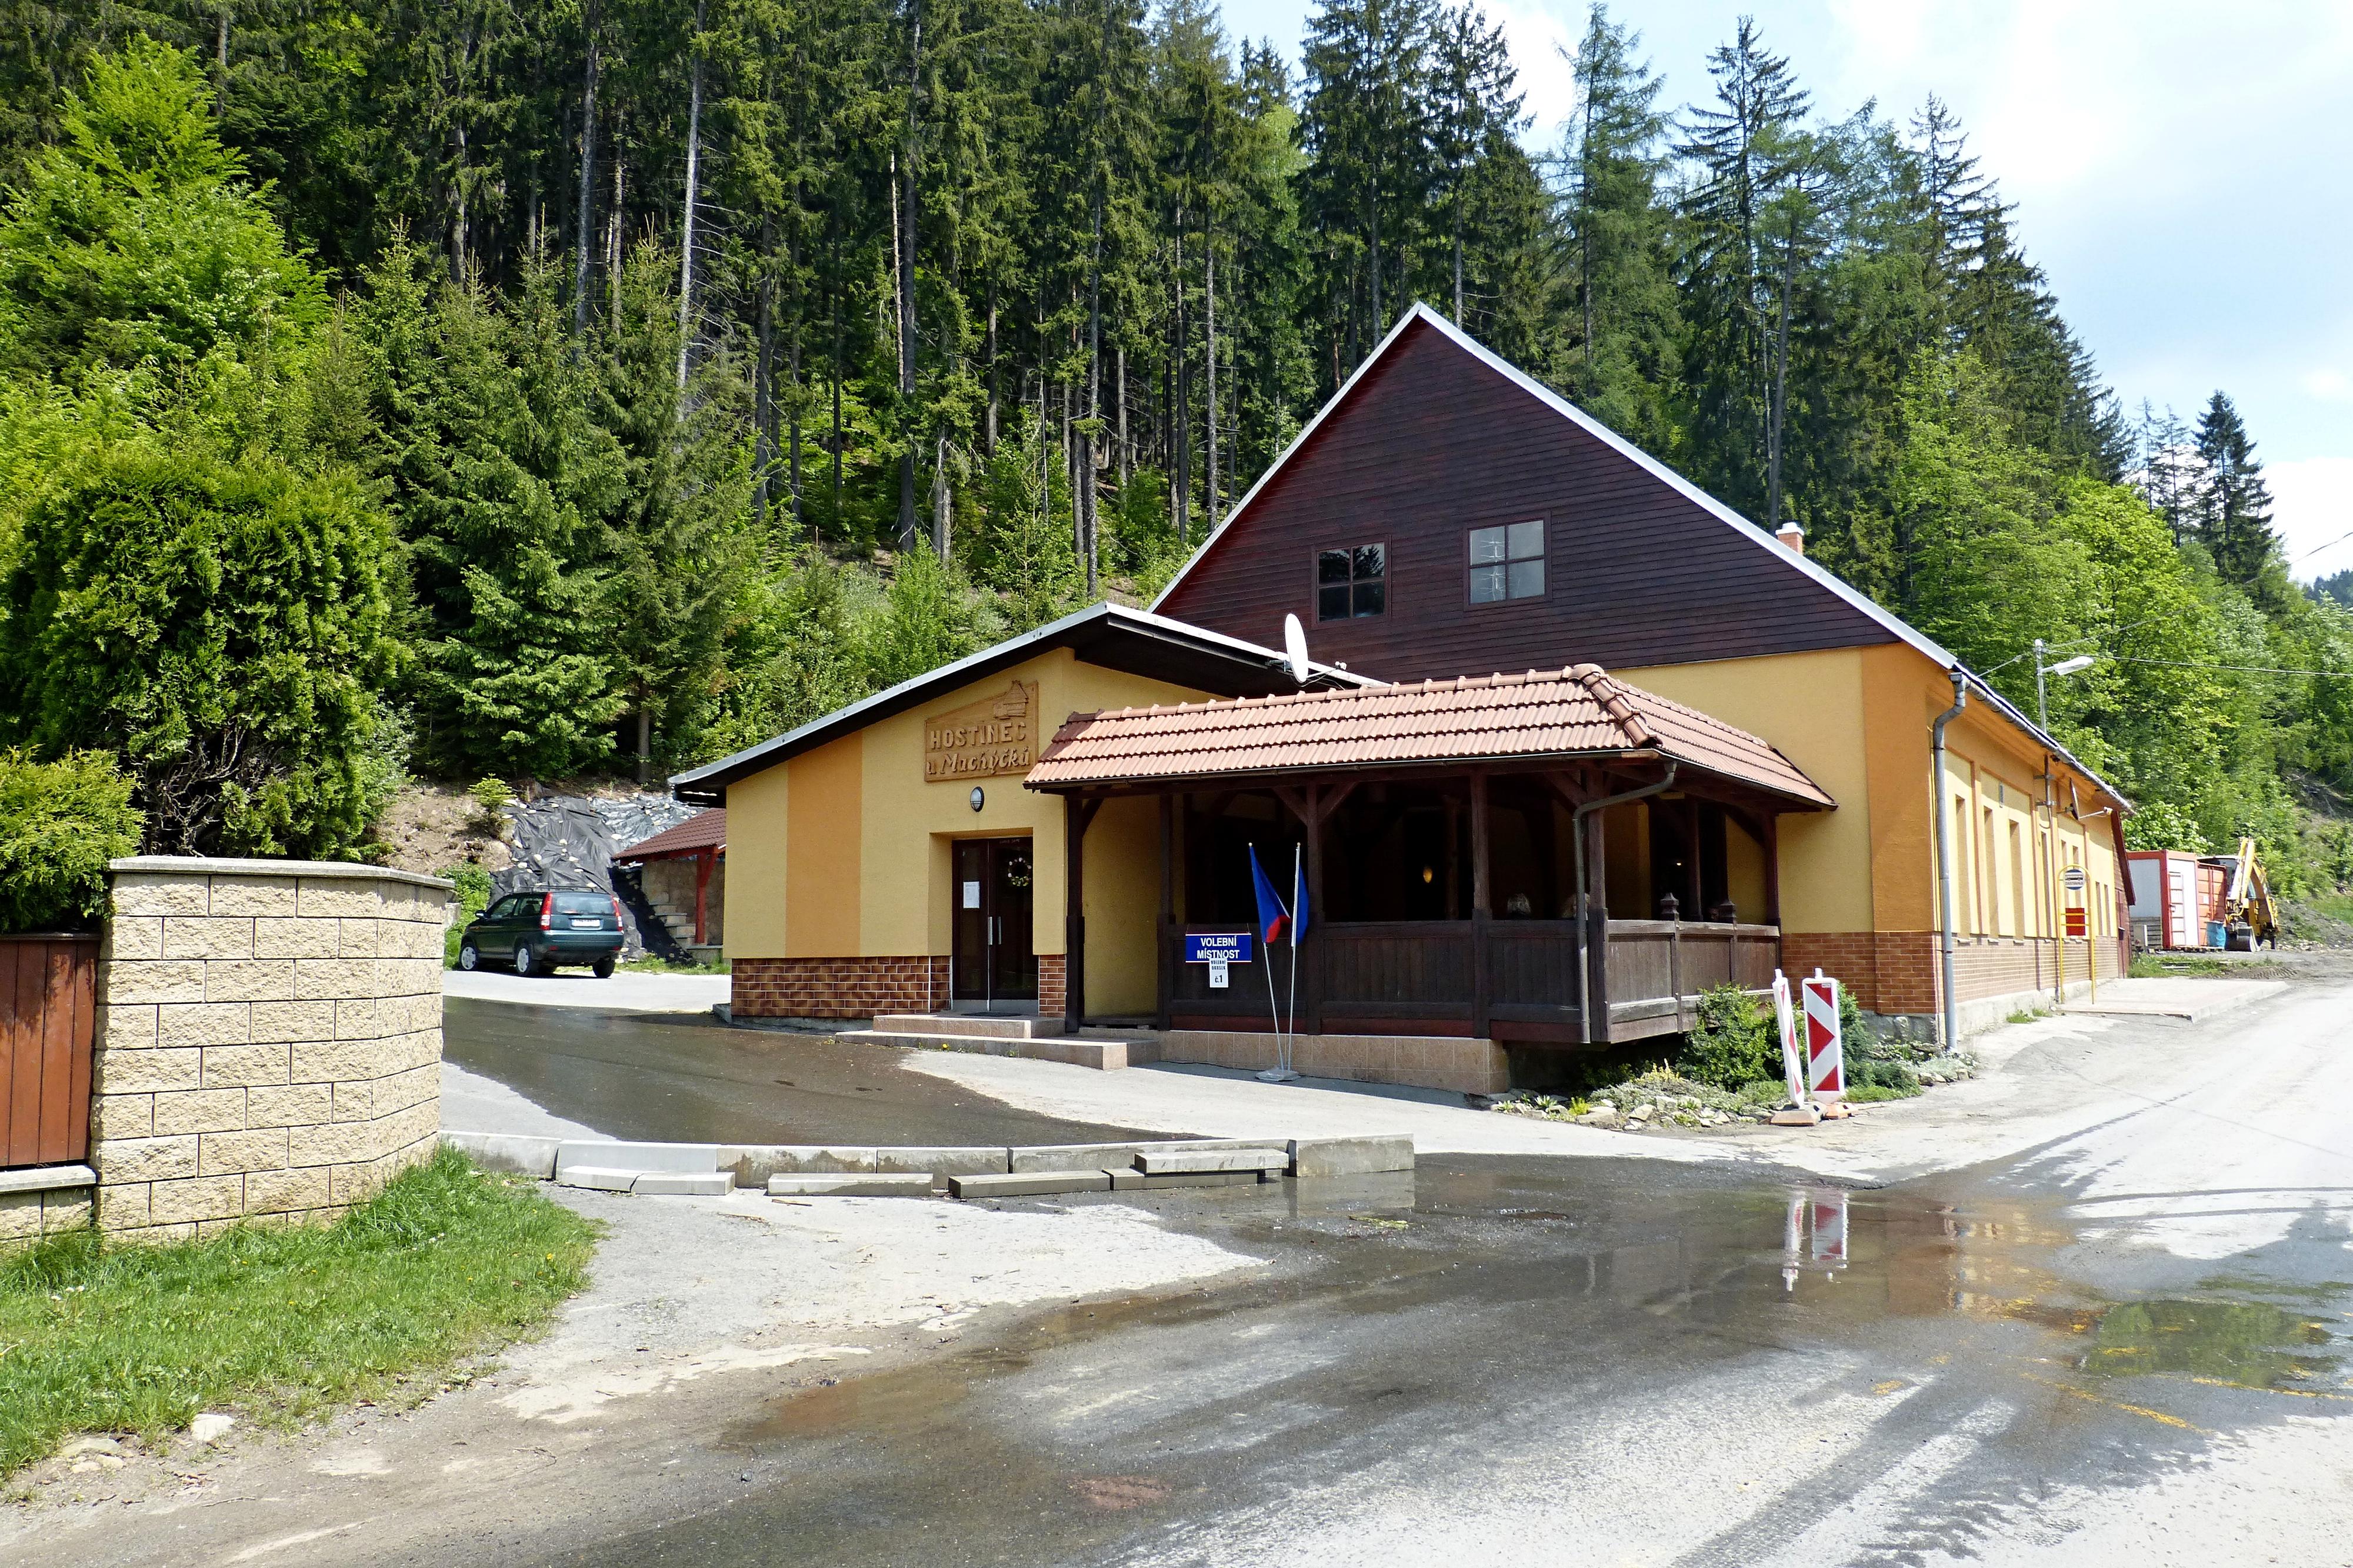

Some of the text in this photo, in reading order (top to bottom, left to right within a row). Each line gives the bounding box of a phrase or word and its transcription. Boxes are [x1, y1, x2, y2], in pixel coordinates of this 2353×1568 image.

[930, 721, 1026, 749] HOSTINEC
[1200, 935, 1237, 947] VOLEBNÍ
[1197, 948, 1240, 959] MÍSTNOST
